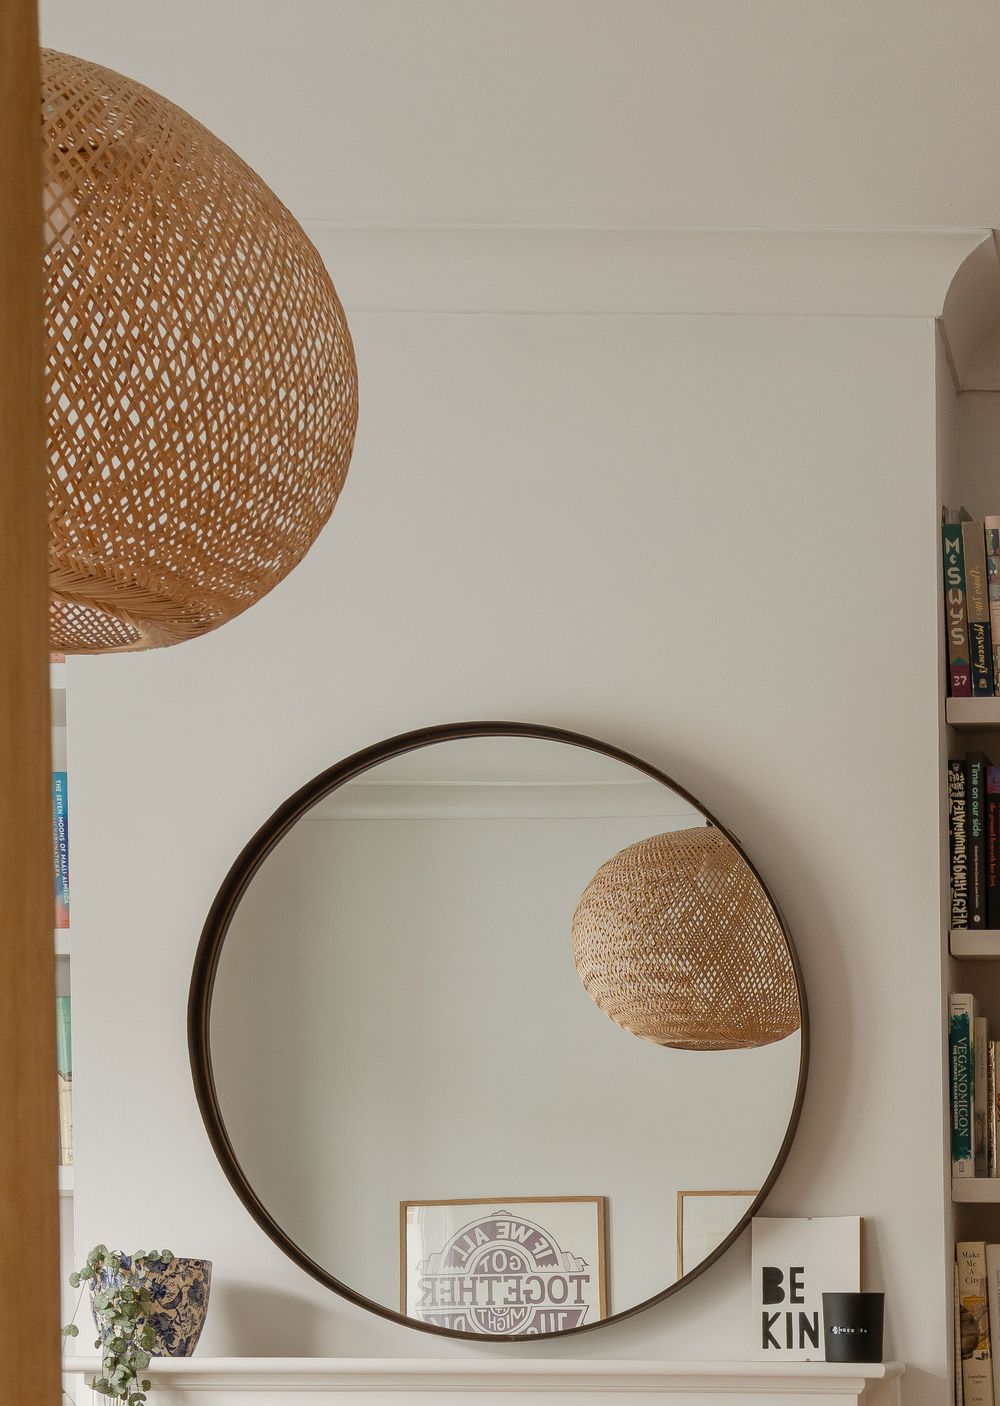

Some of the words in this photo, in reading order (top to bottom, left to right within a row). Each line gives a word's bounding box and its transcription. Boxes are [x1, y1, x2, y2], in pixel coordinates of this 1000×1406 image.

[954, 676, 966, 687] 37
[972, 763, 980, 785] Time
[972, 788, 979, 799] on
[972, 818, 981, 837] side
[60, 843, 66, 851] OF
[957, 1037, 969, 1136] VEGANOMICON
[762, 1267, 804, 1305] BE
[762, 1312, 819, 1349] KIN
